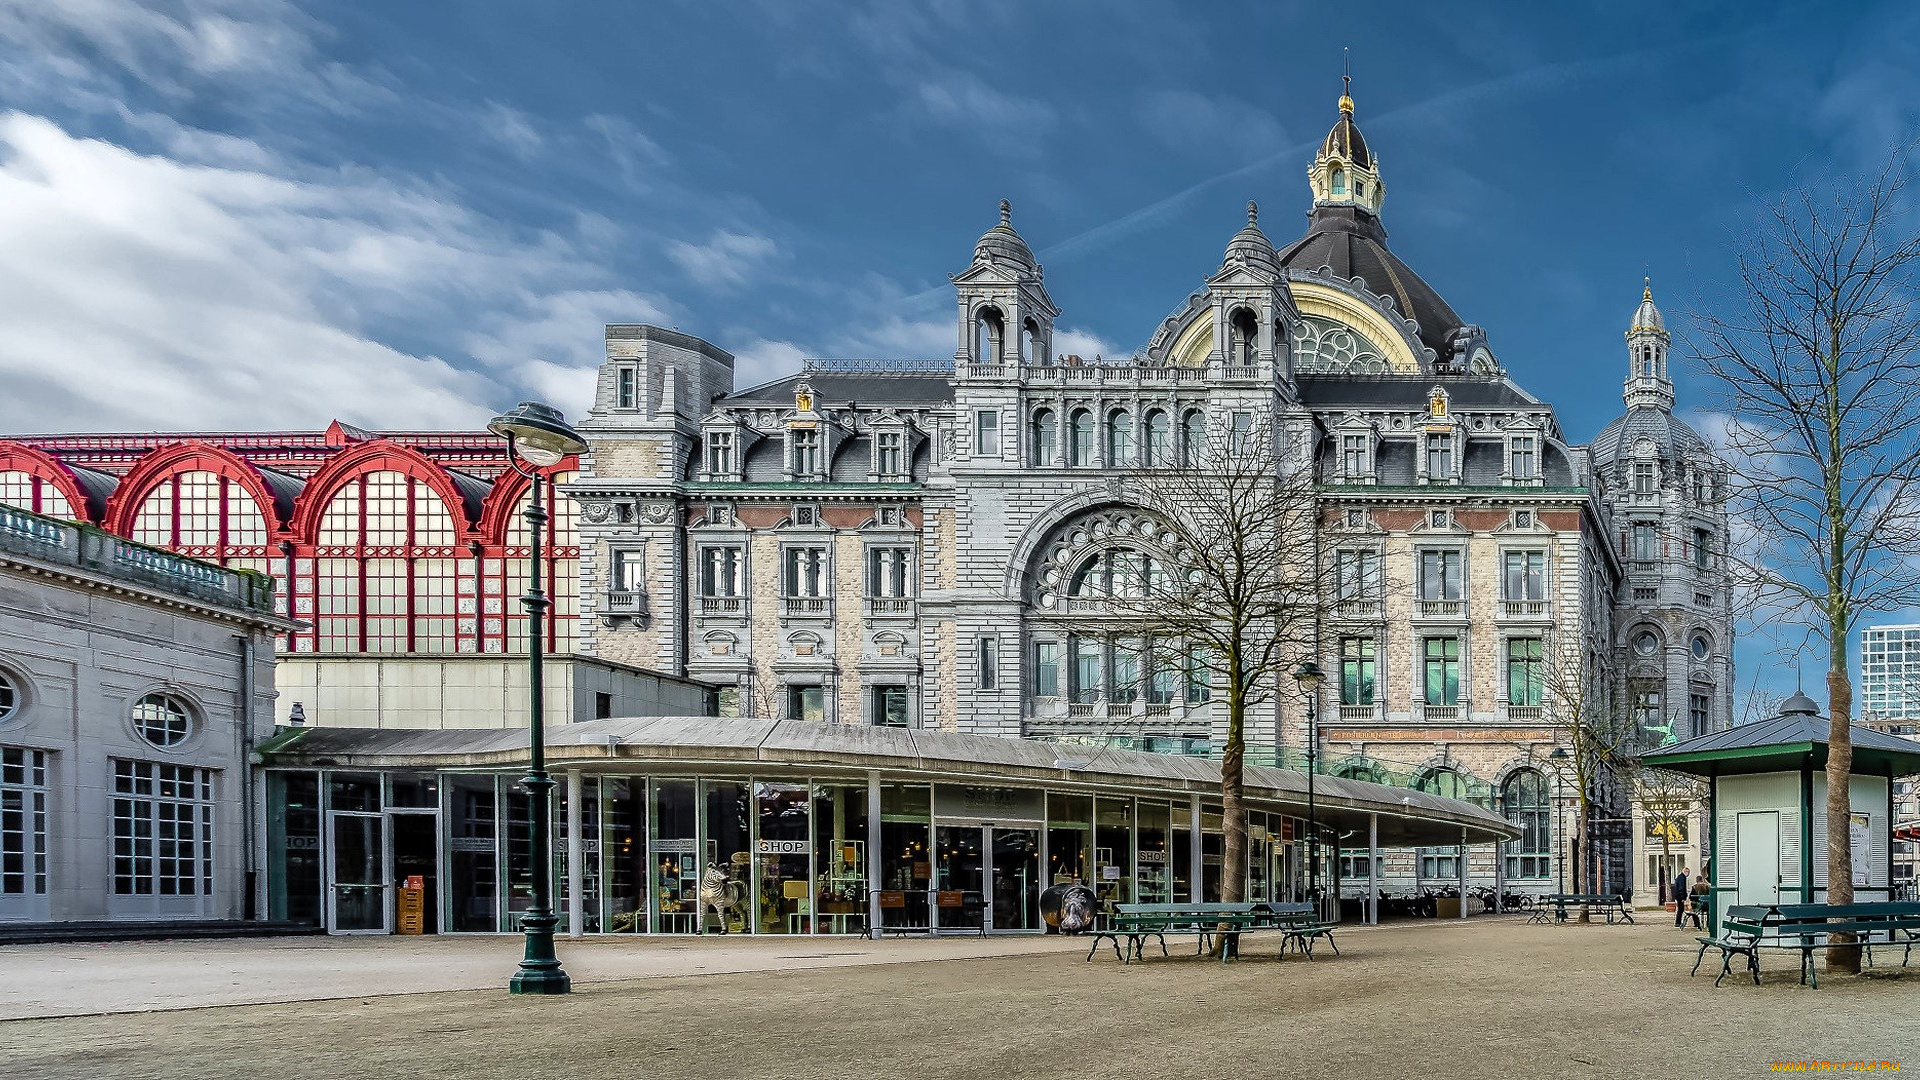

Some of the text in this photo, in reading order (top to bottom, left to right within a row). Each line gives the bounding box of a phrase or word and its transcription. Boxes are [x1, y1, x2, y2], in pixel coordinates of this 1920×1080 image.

[558, 840, 597, 852] SP
[760, 842, 804, 852] SHOP
[1140, 852, 1167, 861] SHOP
